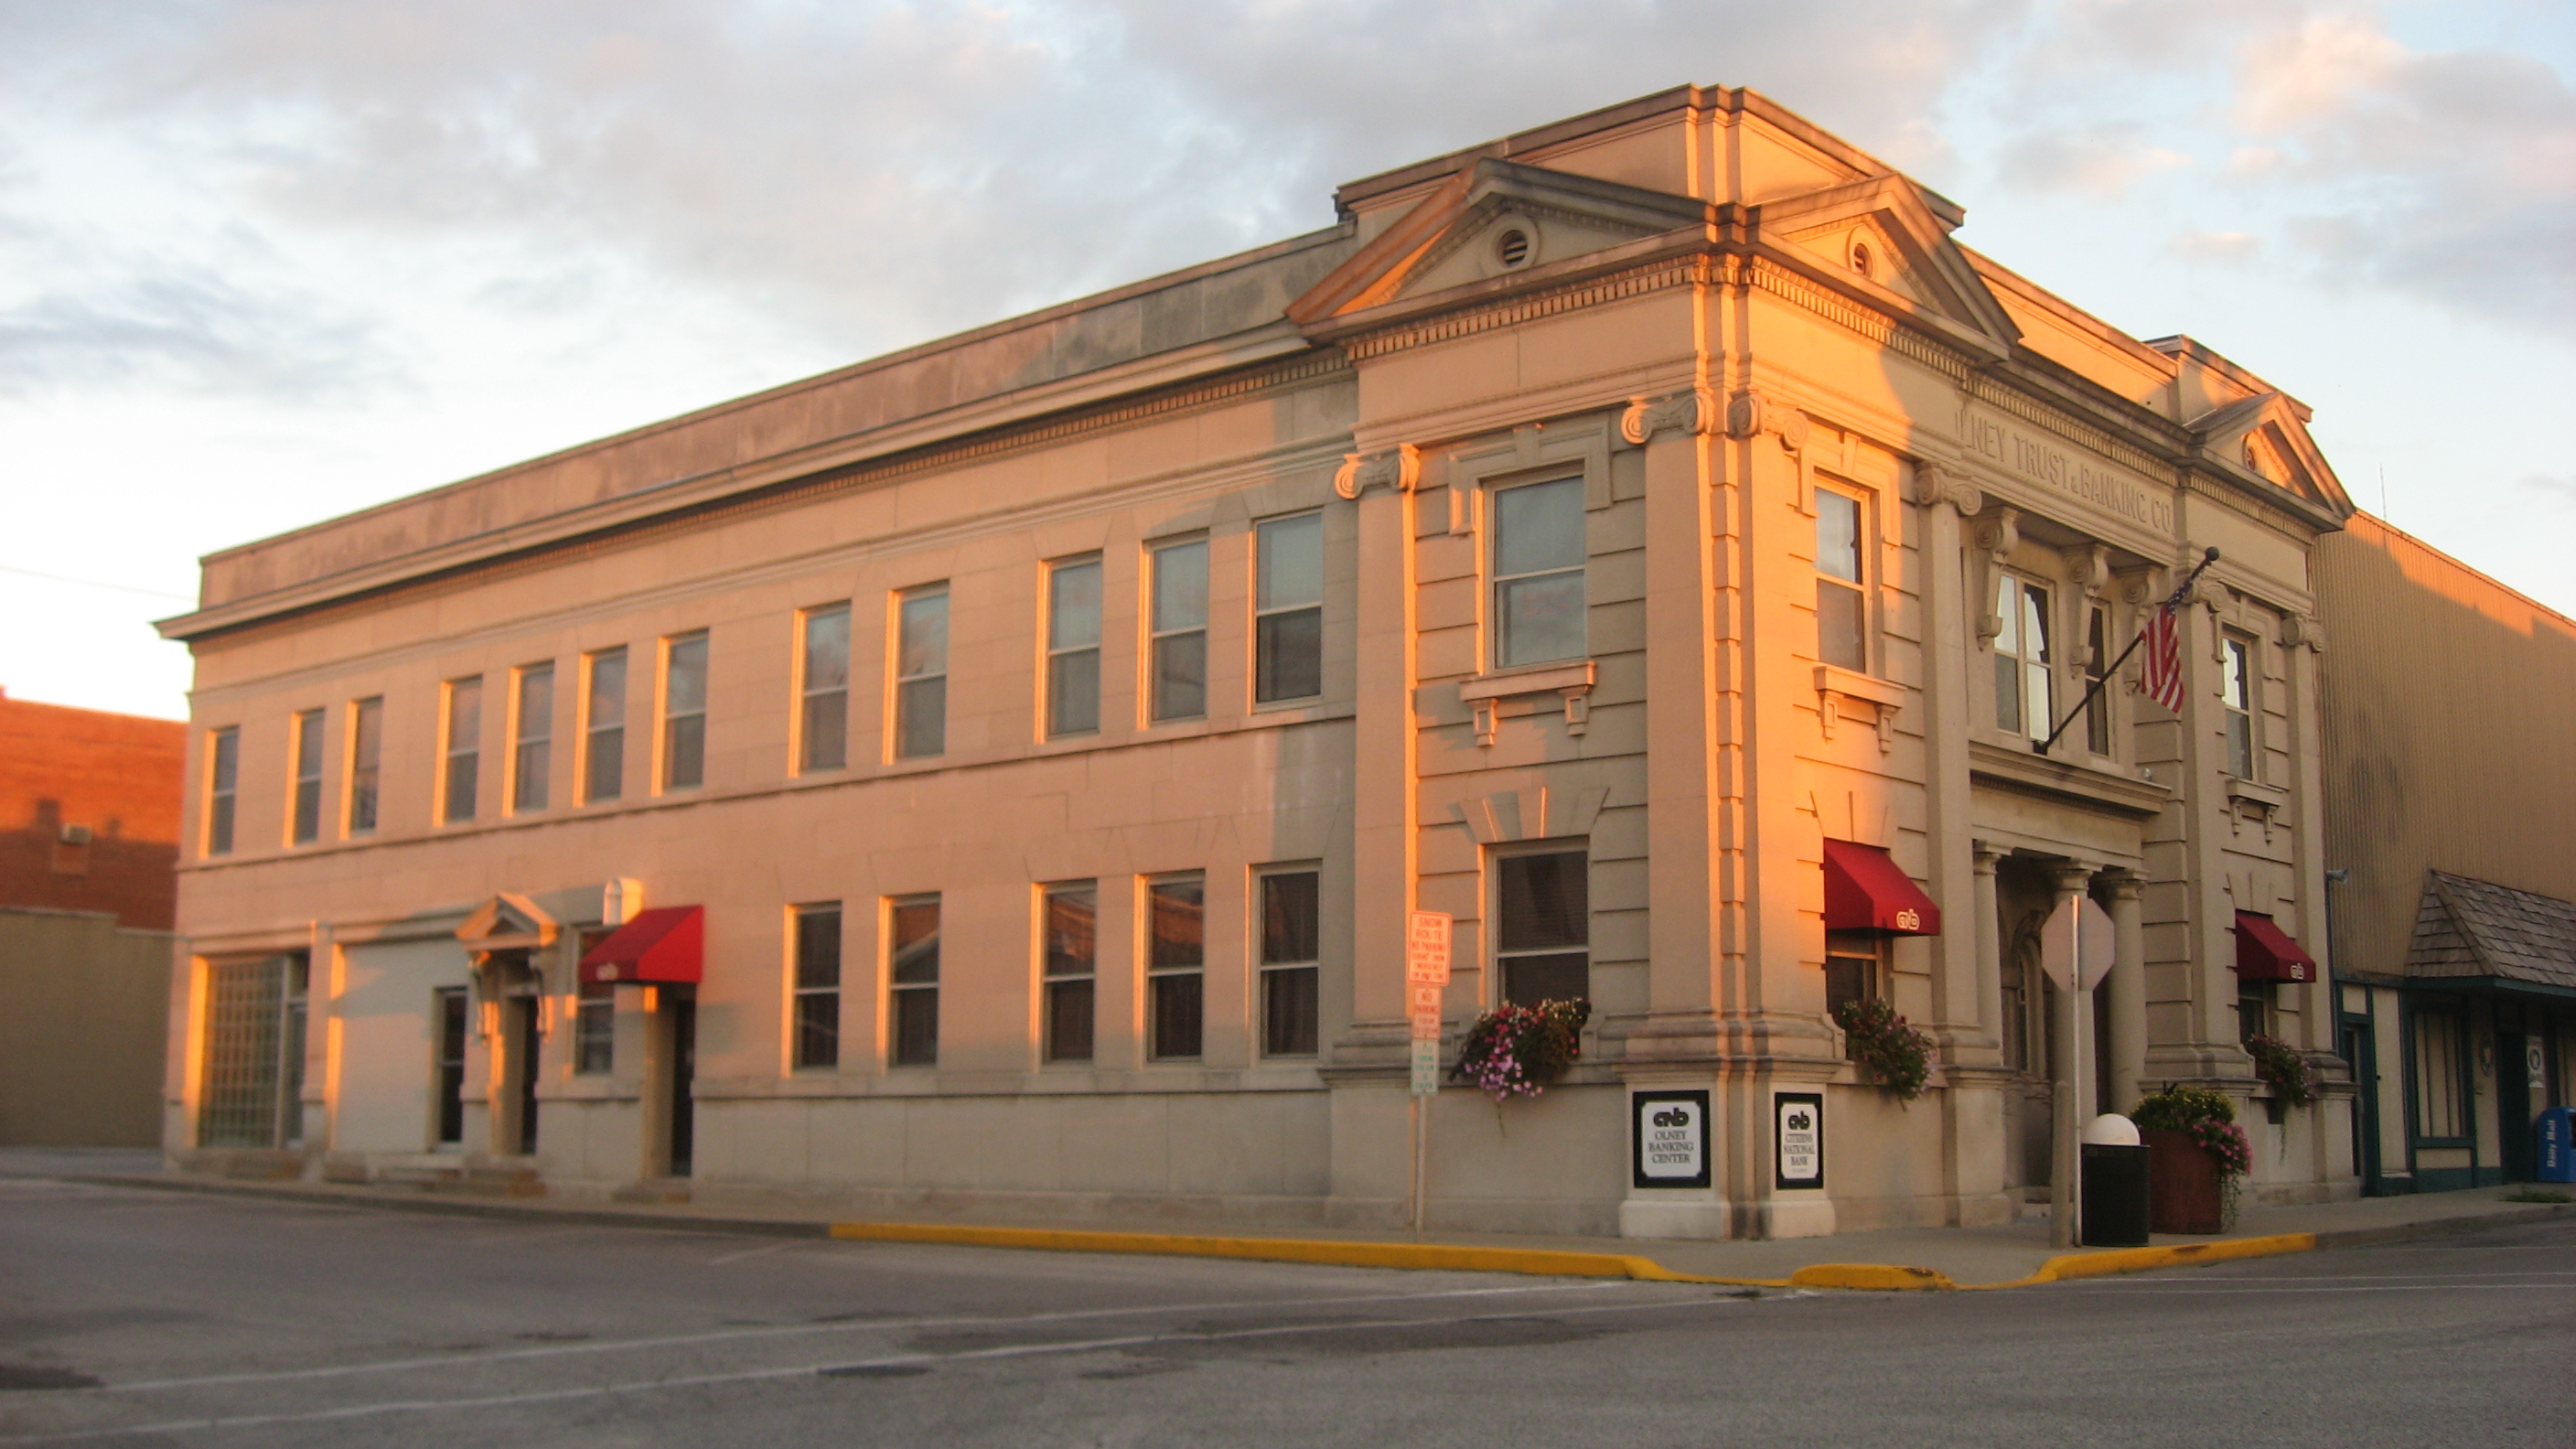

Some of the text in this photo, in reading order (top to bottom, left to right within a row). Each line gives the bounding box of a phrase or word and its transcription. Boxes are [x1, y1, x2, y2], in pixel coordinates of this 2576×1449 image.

[2012, 433, 2069, 488] TRUST
[2080, 463, 2146, 523] BANKING
[1419, 917, 1442, 928] SNOW
[1415, 928, 1443, 940] ROUTE
[1411, 940, 1420, 950] NO
[1422, 992, 1433, 1003] NO
[1655, 1131, 1687, 1141] OLNEY
[1786, 1133, 1813, 1143] CITIZENS
[1648, 1142, 1694, 1152] BANKING
[1783, 1144, 1816, 1154] NATIONAL
[2547, 1120, 2558, 1168] Daily Mail
[1652, 1154, 1690, 1164] CENTER
[1790, 1156, 1809, 1166] BANK
